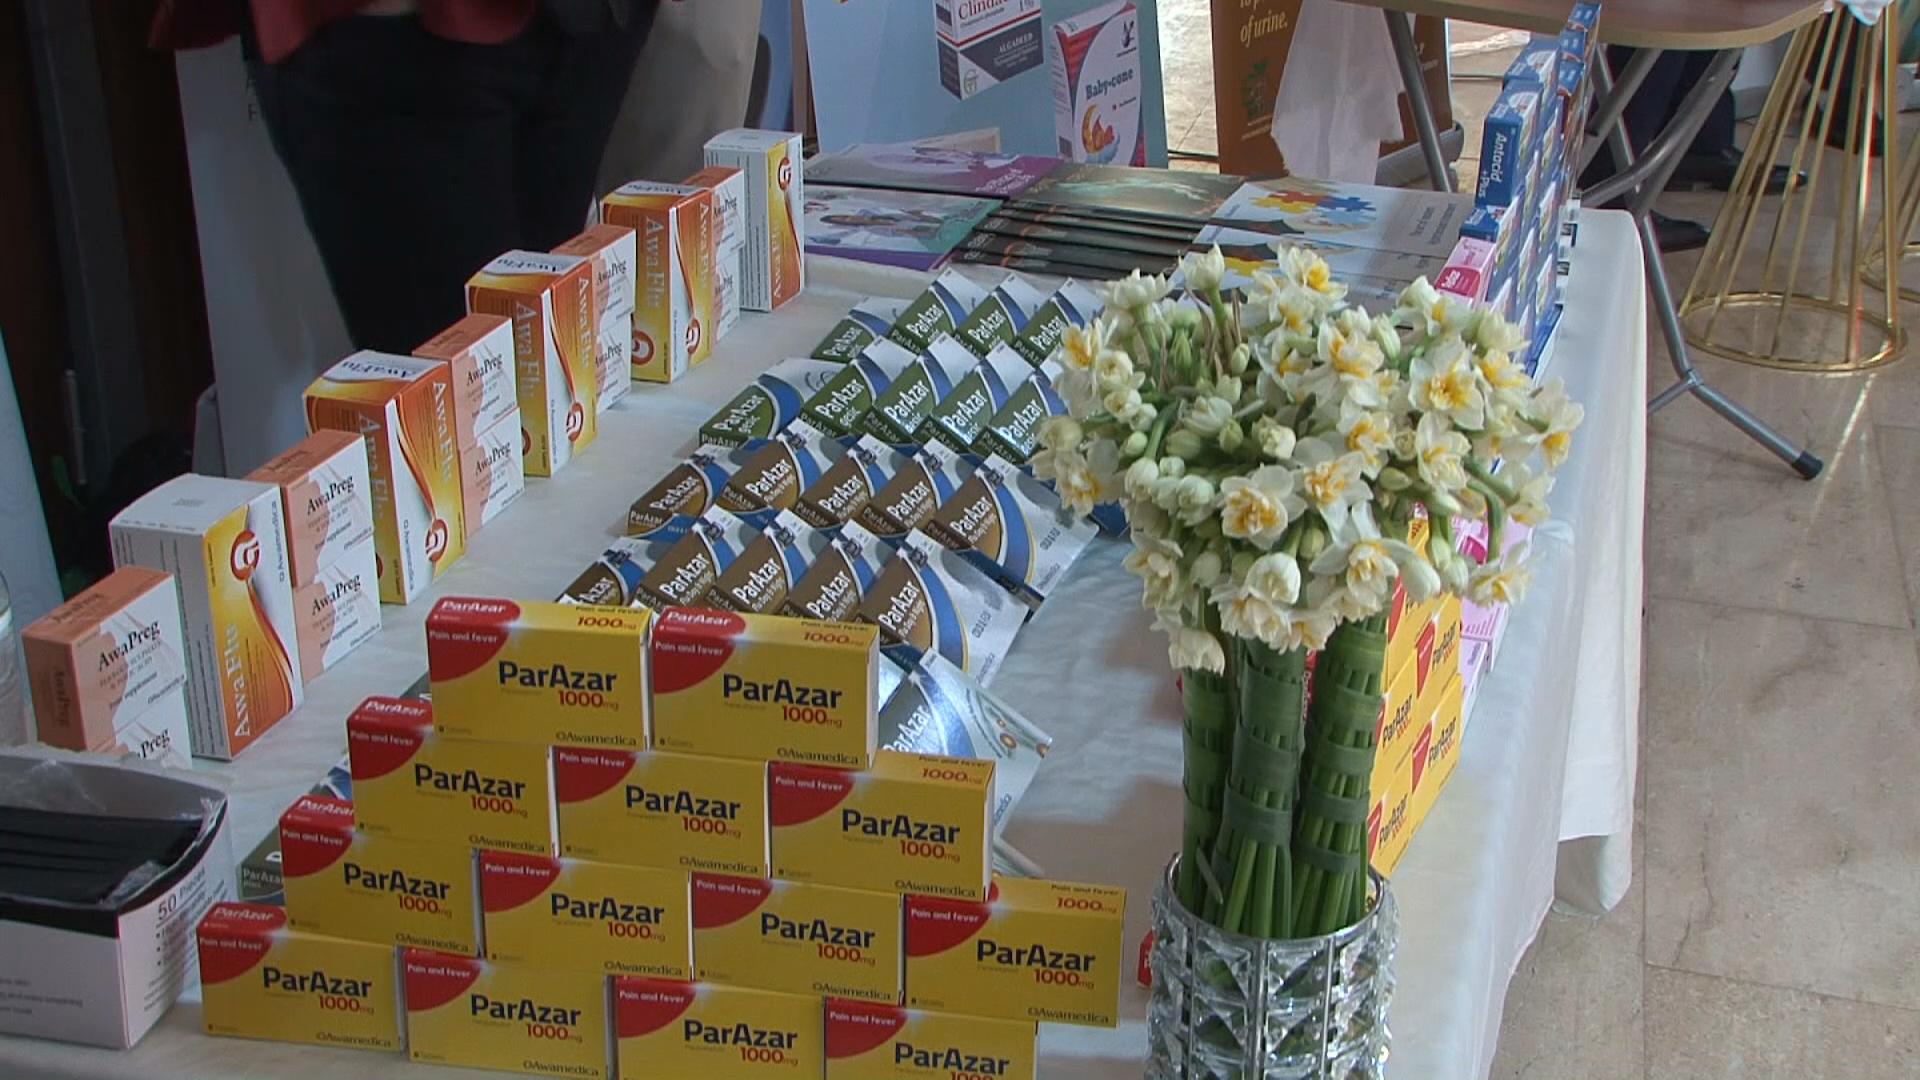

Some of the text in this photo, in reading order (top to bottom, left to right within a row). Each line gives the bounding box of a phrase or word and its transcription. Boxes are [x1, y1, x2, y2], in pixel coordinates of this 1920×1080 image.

[1240, 10, 1288, 48] of urine.
[1491, 133, 1507, 182] Antacid
[905, 304, 944, 339] ParAzar
[967, 309, 1006, 345] ParAzar
[466, 353, 502, 386] AwaPreg
[712, 394, 765, 431] ParAzar
[814, 378, 865, 419] ParAzar
[884, 379, 930, 422] ParAzar
[940, 389, 987, 430] ParAzar
[999, 399, 1043, 440] ParAzar
[702, 434, 739, 447] ParAzar
[475, 441, 511, 476] AwaPreg
[307, 475, 354, 516] AwaPreg
[650, 476, 699, 510] ParAzar
[745, 459, 793, 497] ParAzar
[818, 474, 863, 513] ParAzar
[886, 481, 930, 520] ParAzar
[950, 496, 992, 536] ParAzar
[578, 577, 614, 603] Azar
[659, 553, 710, 599] ParAzar
[732, 557, 780, 605] ParAzar
[312, 574, 361, 616] AwaPreg
[442, 600, 506, 613] ParAzar
[806, 570, 850, 619] ParAzar
[878, 580, 920, 631] ParAzar
[667, 612, 731, 625] ParAzar
[99, 621, 161, 671] AwaPreg
[499, 661, 617, 692] ParAzar
[723, 673, 842, 708] ParAzar
[365, 701, 425, 716] ParAzar
[782, 705, 842, 728] 1000mg
[1383, 694, 1412, 748] ParAzar
[1428, 717, 1456, 768] ParAzar
[415, 763, 525, 799] ParAzar
[626, 785, 740, 819] ParAzar
[843, 809, 960, 843] ParAzar
[1378, 794, 1408, 850] ParAzar
[900, 840, 960, 863] 1000mg
[344, 863, 450, 899] ParAzar
[157, 894, 179, 920] 50
[214, 907, 274, 921] ParAzar
[551, 893, 664, 924] ParAzar
[608, 921, 665, 942] 1000mg
[761, 913, 875, 948] ParAzar
[977, 939, 1095, 971] ParAzar
[263, 966, 372, 997] ParAzar
[1035, 969, 1094, 990] 1000mg
[471, 994, 581, 1025] ParAzar
[684, 1019, 798, 1049] ParAzar
[896, 1042, 1010, 1076] ParAzar
